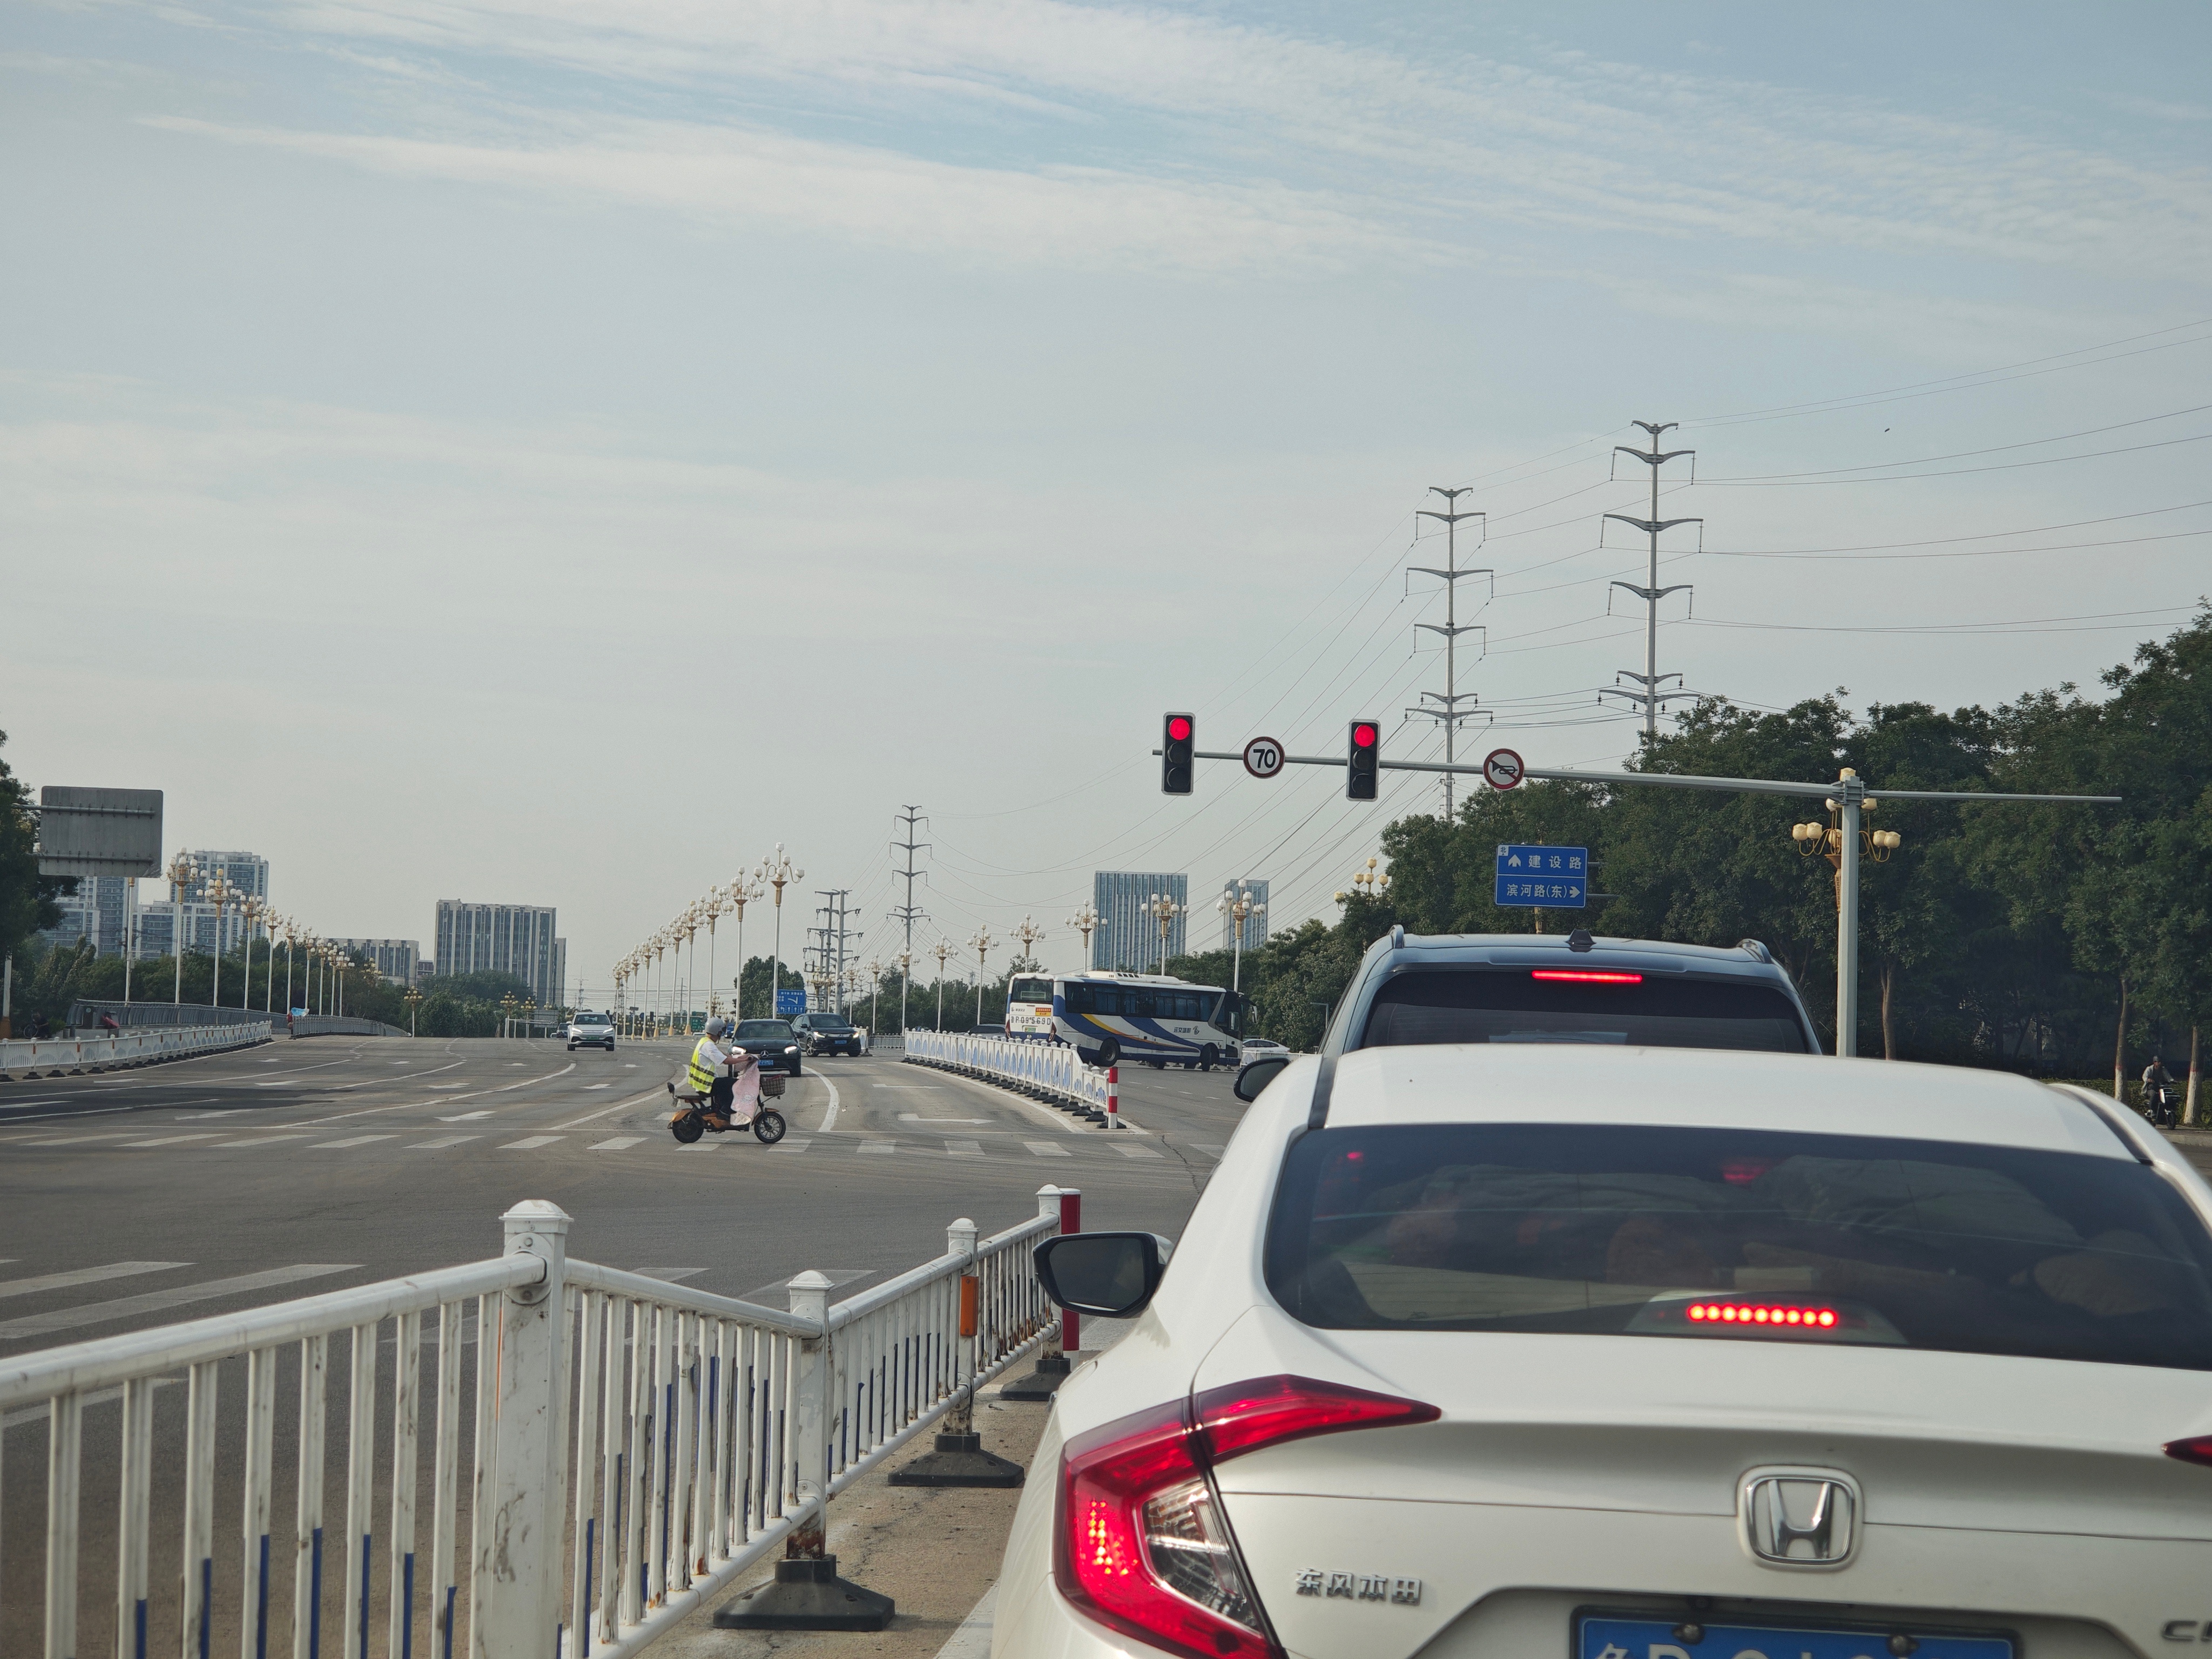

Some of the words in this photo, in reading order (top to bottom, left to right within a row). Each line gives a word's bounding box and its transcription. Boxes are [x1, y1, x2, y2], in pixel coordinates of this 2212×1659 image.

[1253, 748, 1276, 768] 70
[1528, 855, 1582, 869] 建设路
[1507, 884, 1567, 898] 滨河路(东)
[1296, 1568, 1422, 1607] 东风本田
